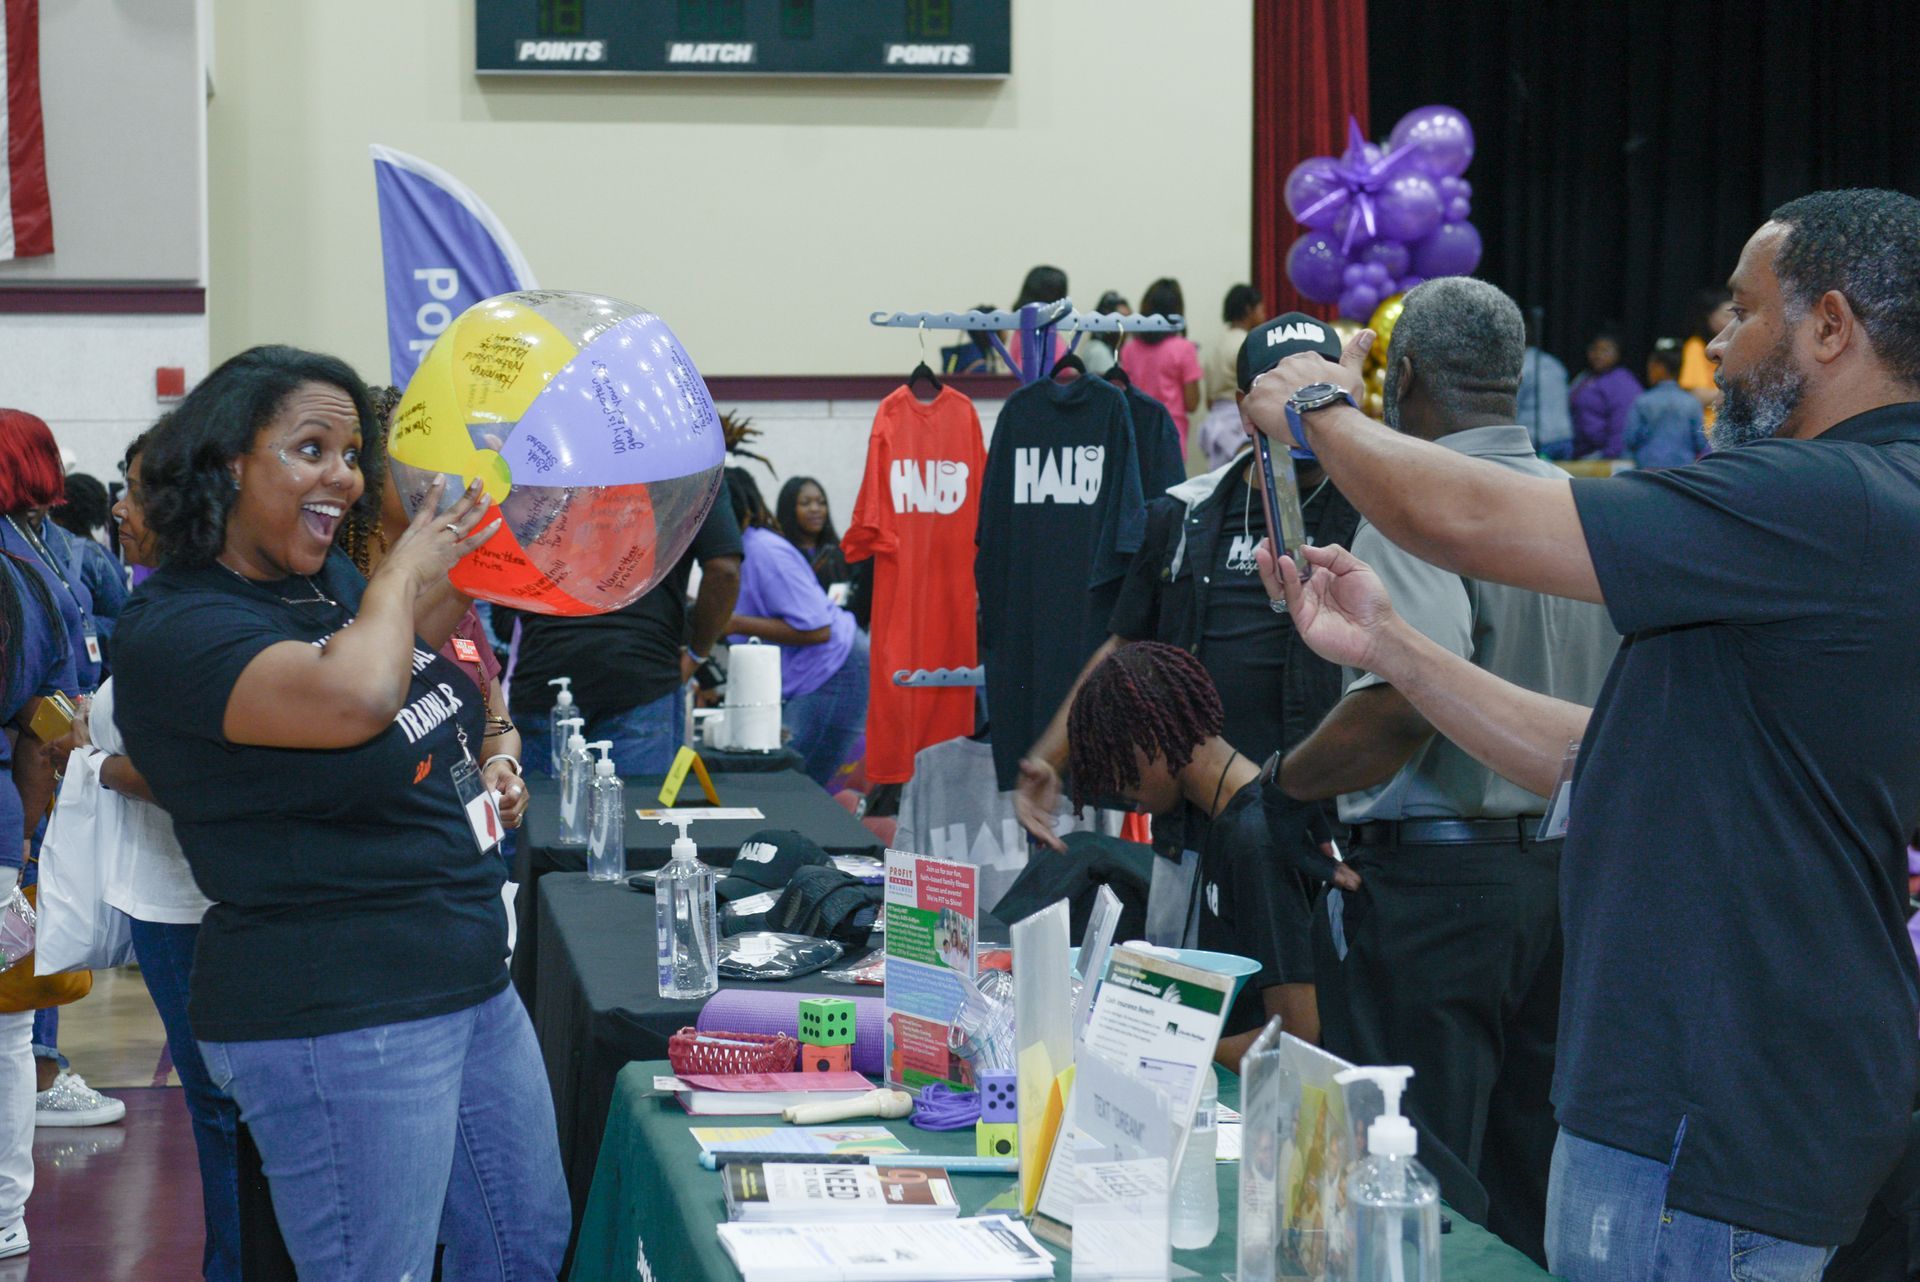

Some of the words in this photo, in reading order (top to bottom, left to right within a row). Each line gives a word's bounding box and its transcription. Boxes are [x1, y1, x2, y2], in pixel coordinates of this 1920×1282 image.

[518, 41, 603, 61] POINTS
[670, 43, 751, 63] MATCH
[887, 44, 971, 65] POINTS
[890, 866, 912, 878] PROFIT
